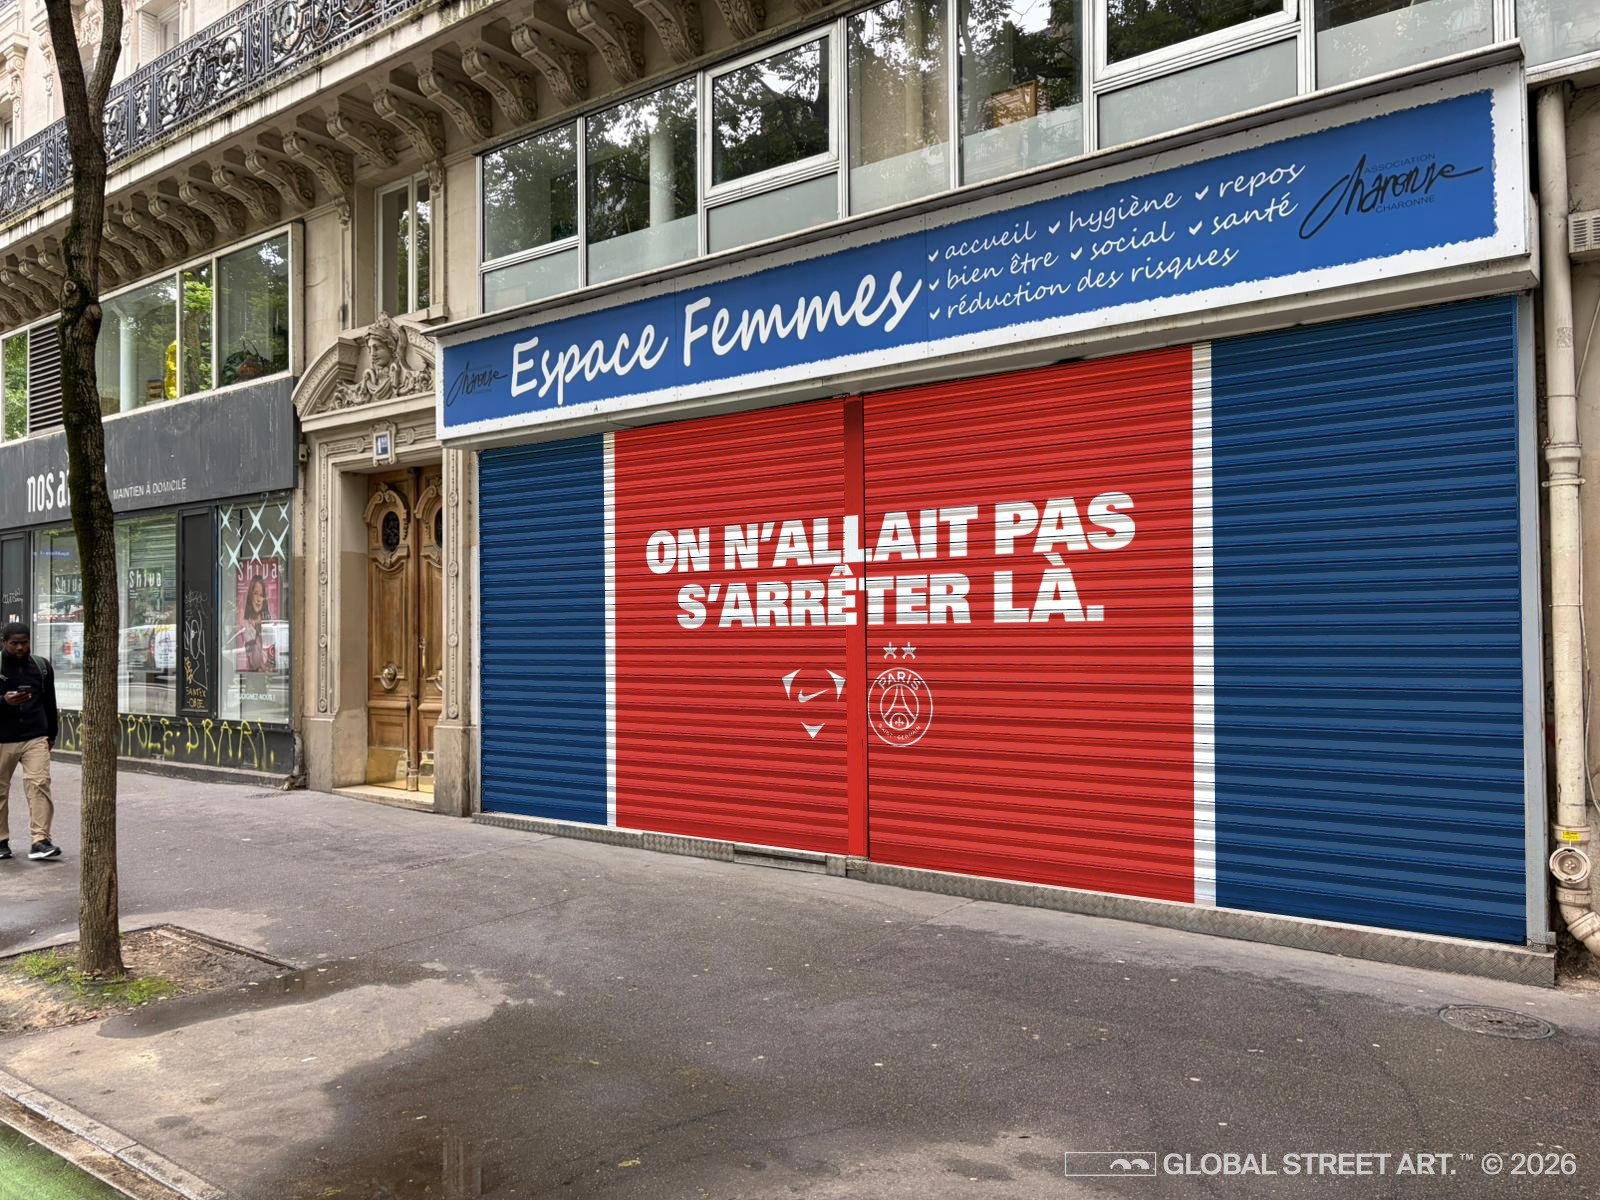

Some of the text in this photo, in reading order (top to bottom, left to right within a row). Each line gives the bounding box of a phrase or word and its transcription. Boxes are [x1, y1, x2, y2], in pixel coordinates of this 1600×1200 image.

[1365, 151, 1436, 174] ASSOCIATION
[945, 163, 1306, 260] accueil hygiène repos
[1375, 193, 1436, 214] CHARONNE
[947, 191, 1299, 290] bien être social santé
[947, 247, 1240, 319] réduction des risques
[510, 270, 923, 405] Espace Femmes
[113, 484, 144, 500] MAINTIEN
[152, 478, 187, 494] DOMICILE
[646, 491, 1136, 575] ON N'ALLAIT PAS
[129, 569, 162, 588] Shiva
[238, 560, 278, 581] Shiva
[676, 552, 1105, 630] S'ARRÊTER LÀ.
[878, 671, 922, 691] PARIS
